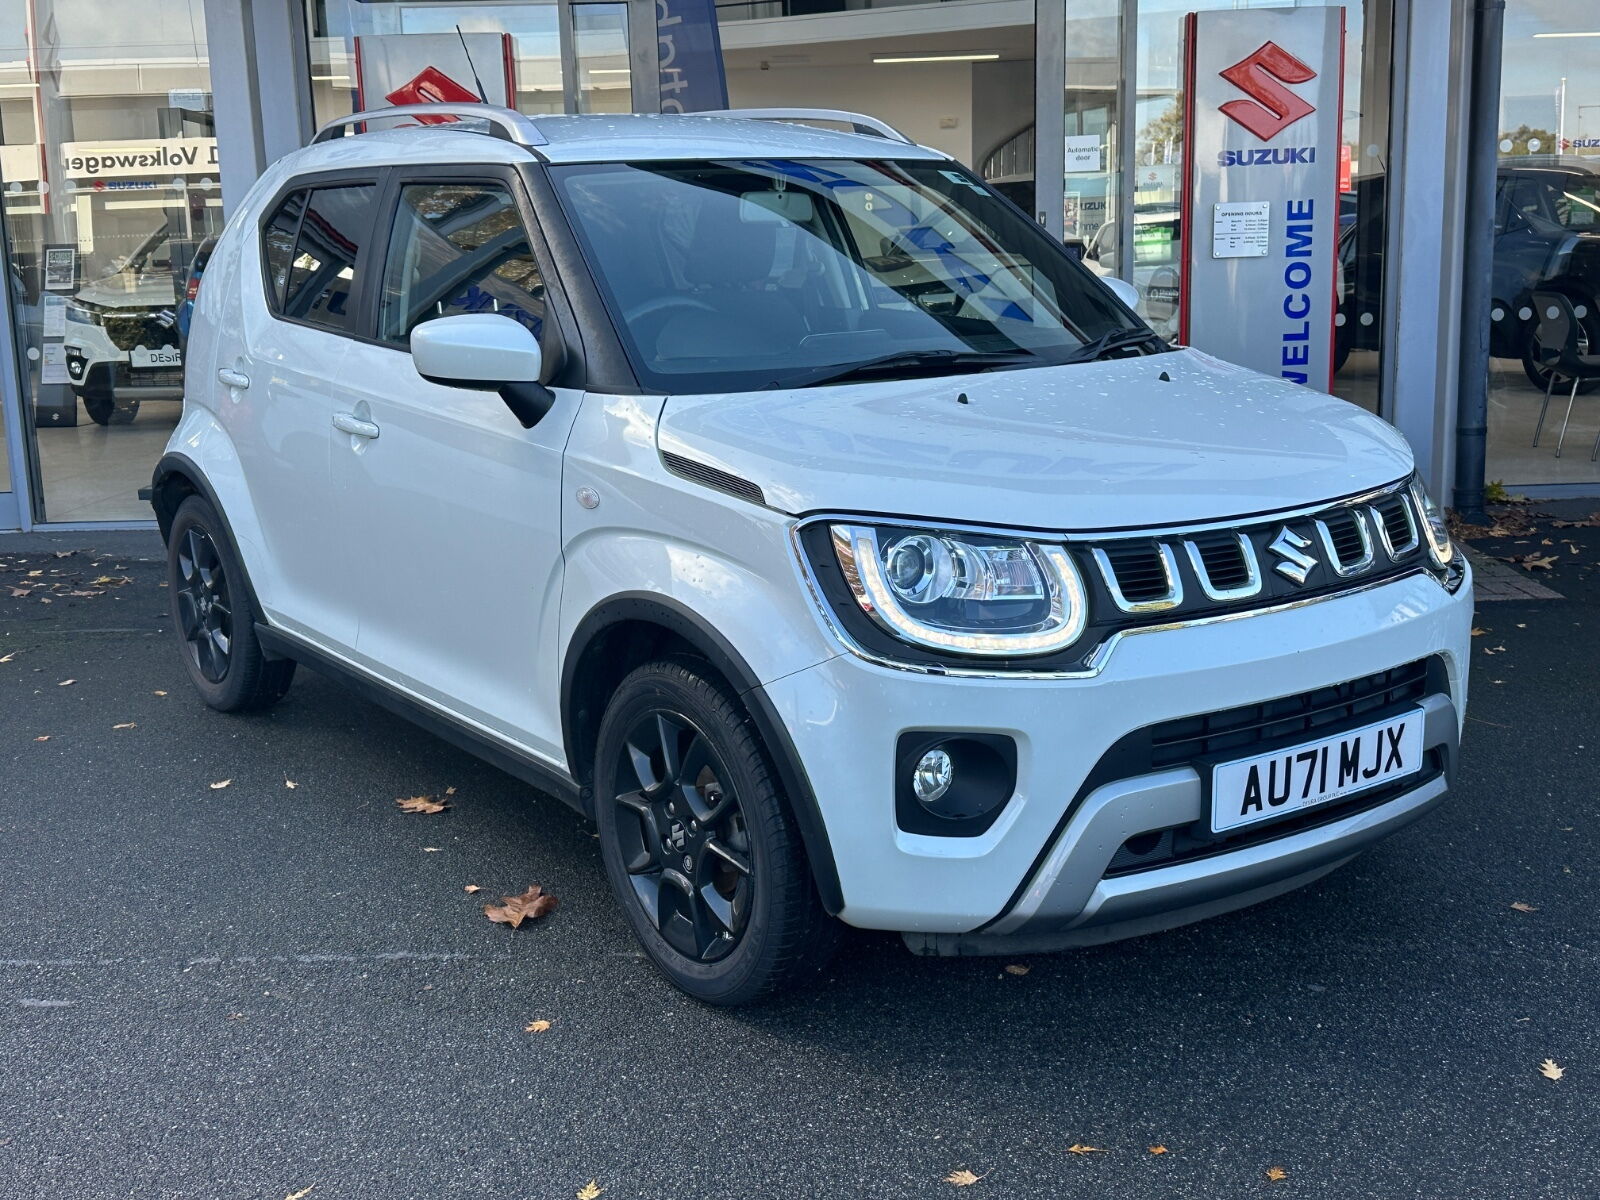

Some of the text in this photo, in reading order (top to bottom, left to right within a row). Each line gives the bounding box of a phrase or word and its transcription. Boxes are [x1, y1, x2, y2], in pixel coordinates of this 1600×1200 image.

[1217, 147, 1316, 167] SUZUKI
[107, 180, 158, 190] SUZUKI
[1240, 723, 1406, 816] AU71 MJX
